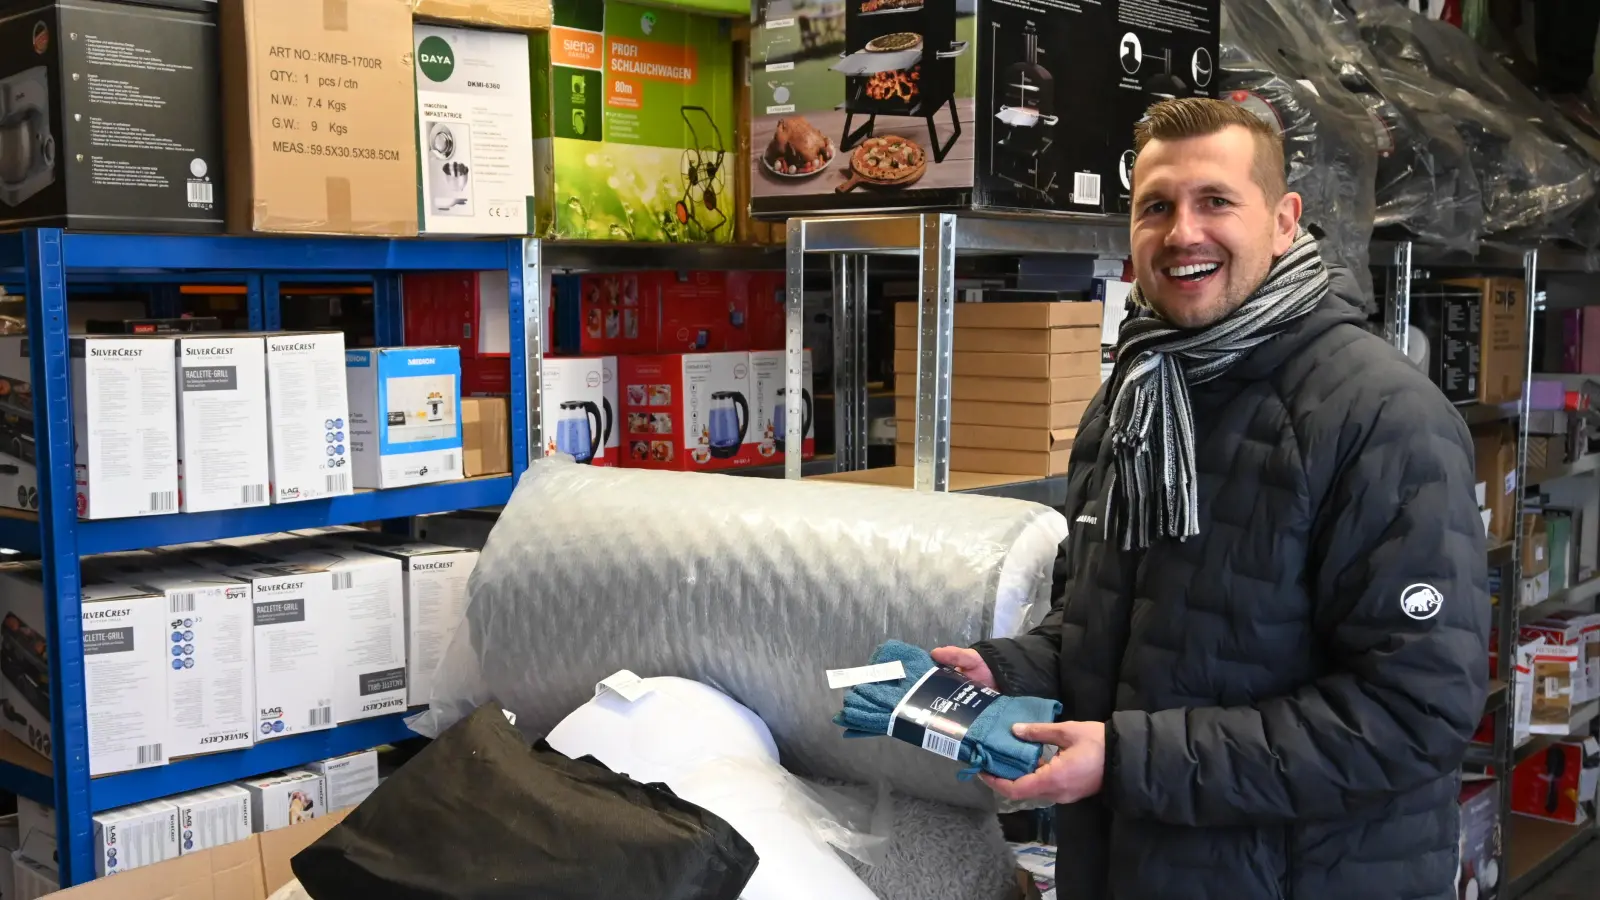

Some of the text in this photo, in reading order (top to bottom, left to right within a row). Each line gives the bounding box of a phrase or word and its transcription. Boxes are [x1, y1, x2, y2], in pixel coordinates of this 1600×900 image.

[564, 39, 595, 53] siena
[612, 43, 638, 57] PROFI
[269, 46, 292, 59] ART
[421, 53, 452, 65] DAYA
[611, 59, 692, 79] SCHLAUCHWAGEN
[304, 74, 309, 84] 1
[318, 76, 336, 88] pcs
[344, 79, 359, 89] ctn
[467, 80, 501, 90] DKMI-6360
[615, 81, 633, 94] 80m
[306, 97, 323, 109] 7.4
[328, 99, 347, 113] Kgs
[424, 110, 463, 119] IMPASTATRICE
[311, 121, 318, 131] 9
[329, 122, 348, 135] Kgs
[408, 358, 436, 366] MEDION
[186, 370, 229, 379] RACLETTE-GRILL
[82, 608, 131, 619] ILVERCREST
[257, 603, 299, 614] RACLETTE-GRILL
[84, 631, 125, 642] CLETTE-GRILL
